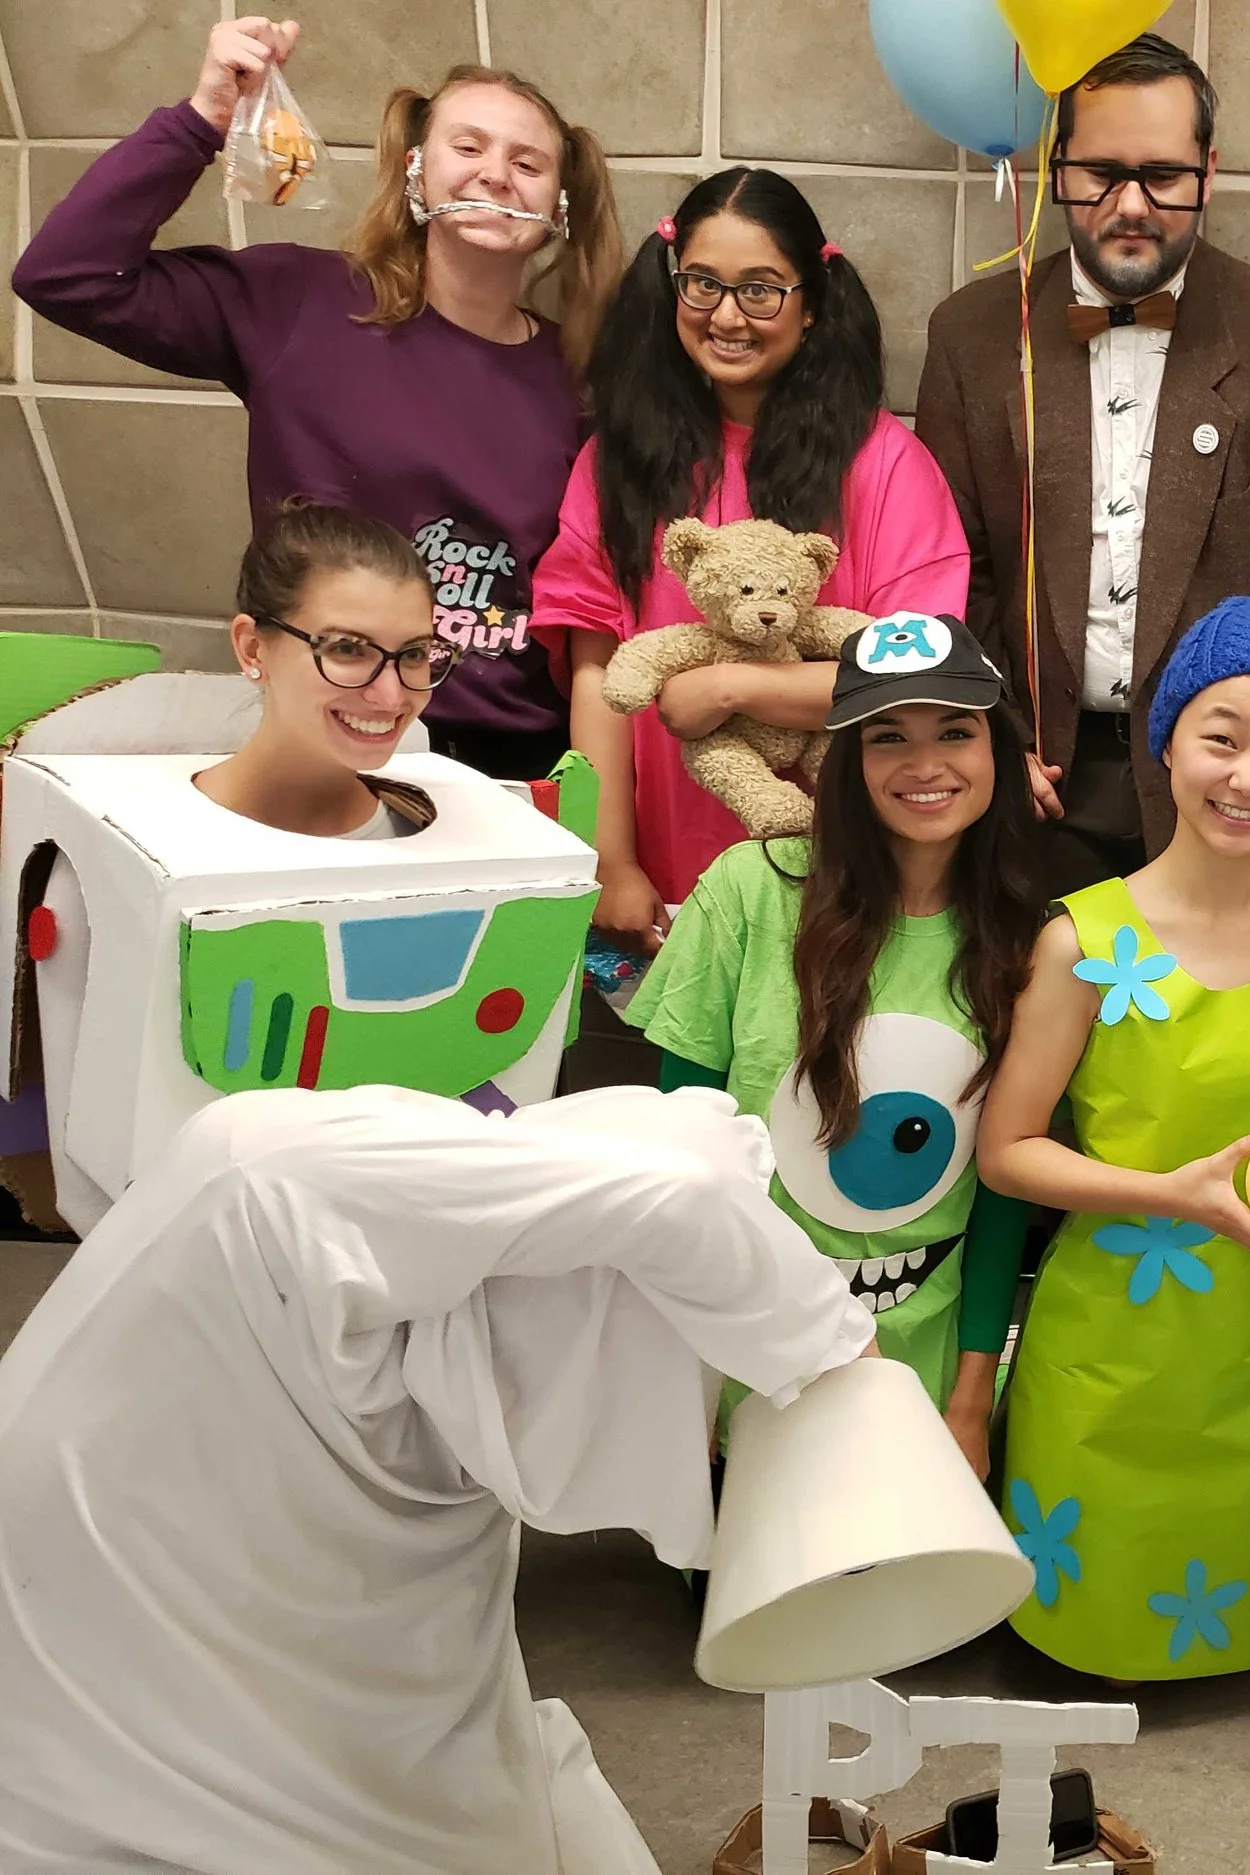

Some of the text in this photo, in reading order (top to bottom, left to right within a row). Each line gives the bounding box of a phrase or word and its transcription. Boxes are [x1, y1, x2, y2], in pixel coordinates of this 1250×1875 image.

[411, 518, 516, 577] Rock
[441, 563, 466, 584] n
[433, 605, 528, 651] Girl
